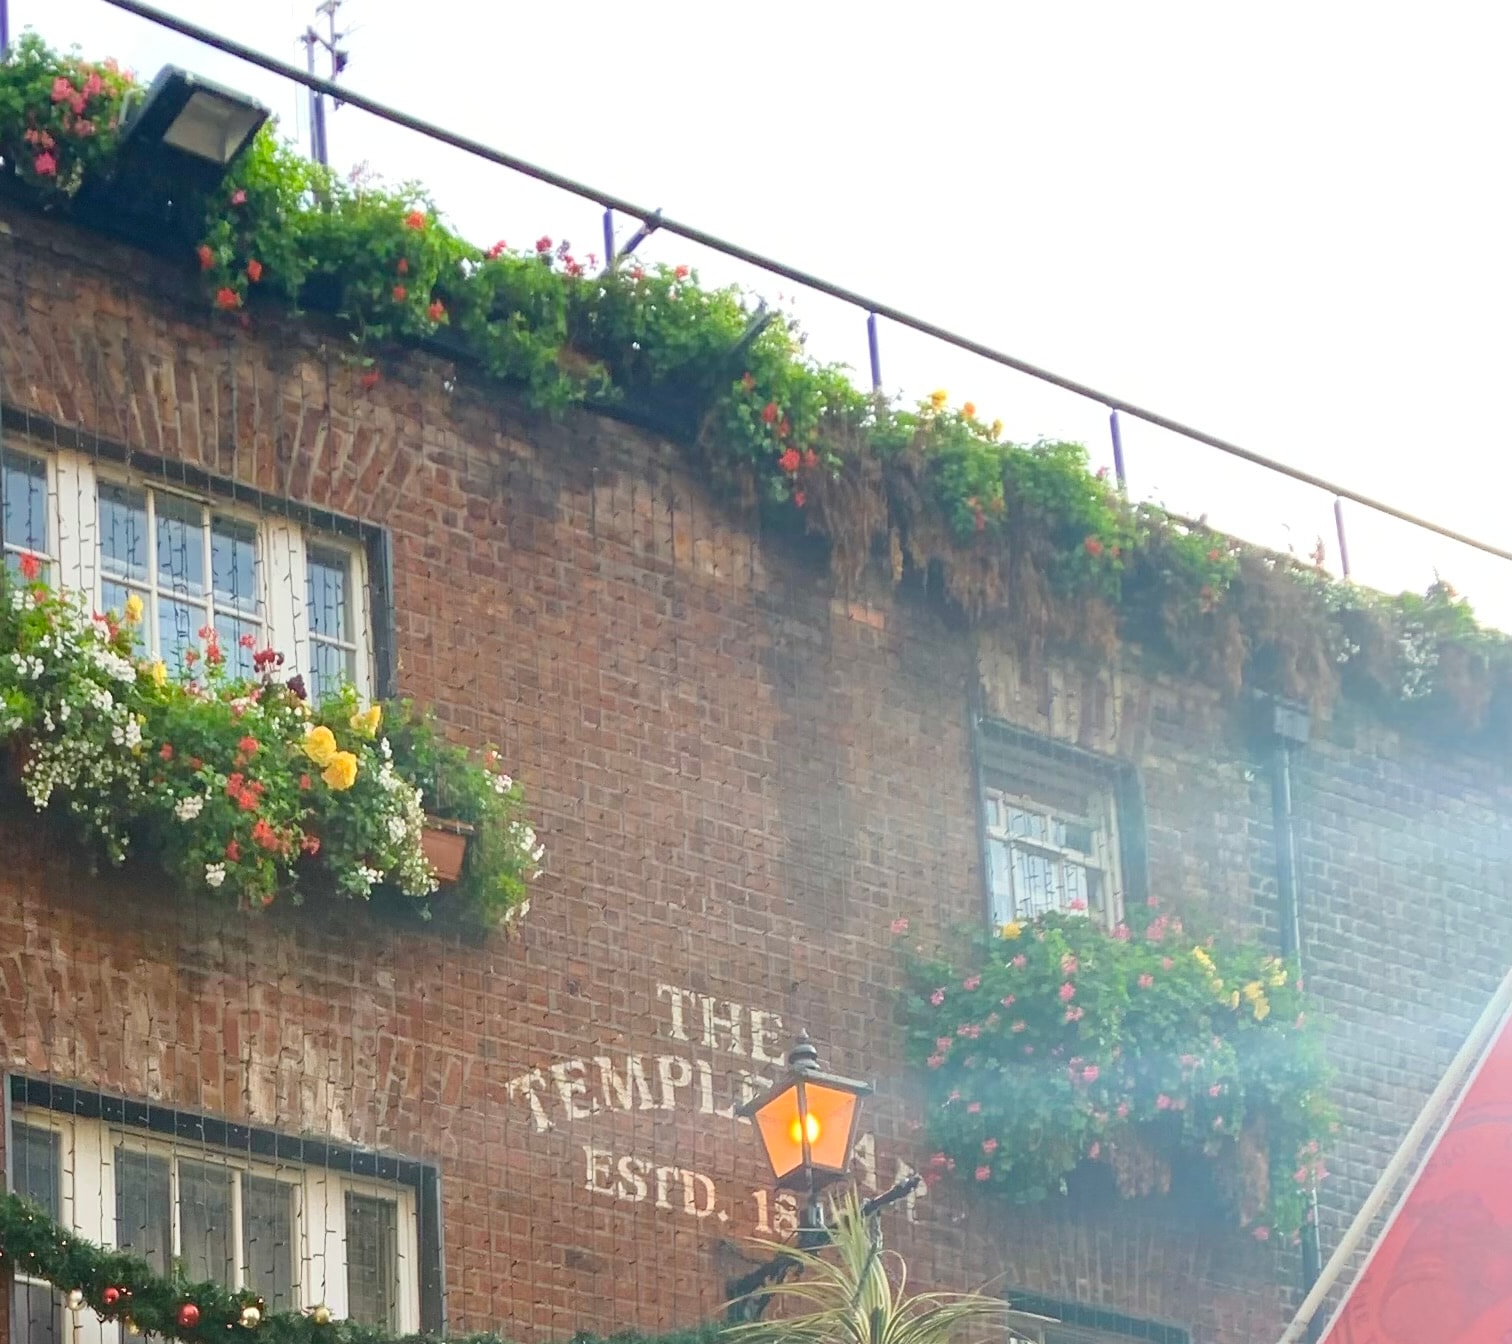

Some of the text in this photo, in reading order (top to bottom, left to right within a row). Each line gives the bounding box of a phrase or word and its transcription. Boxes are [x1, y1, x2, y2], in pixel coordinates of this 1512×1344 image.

[657, 983, 785, 1066] THE
[583, 1145, 799, 1237] ESTD. 18
